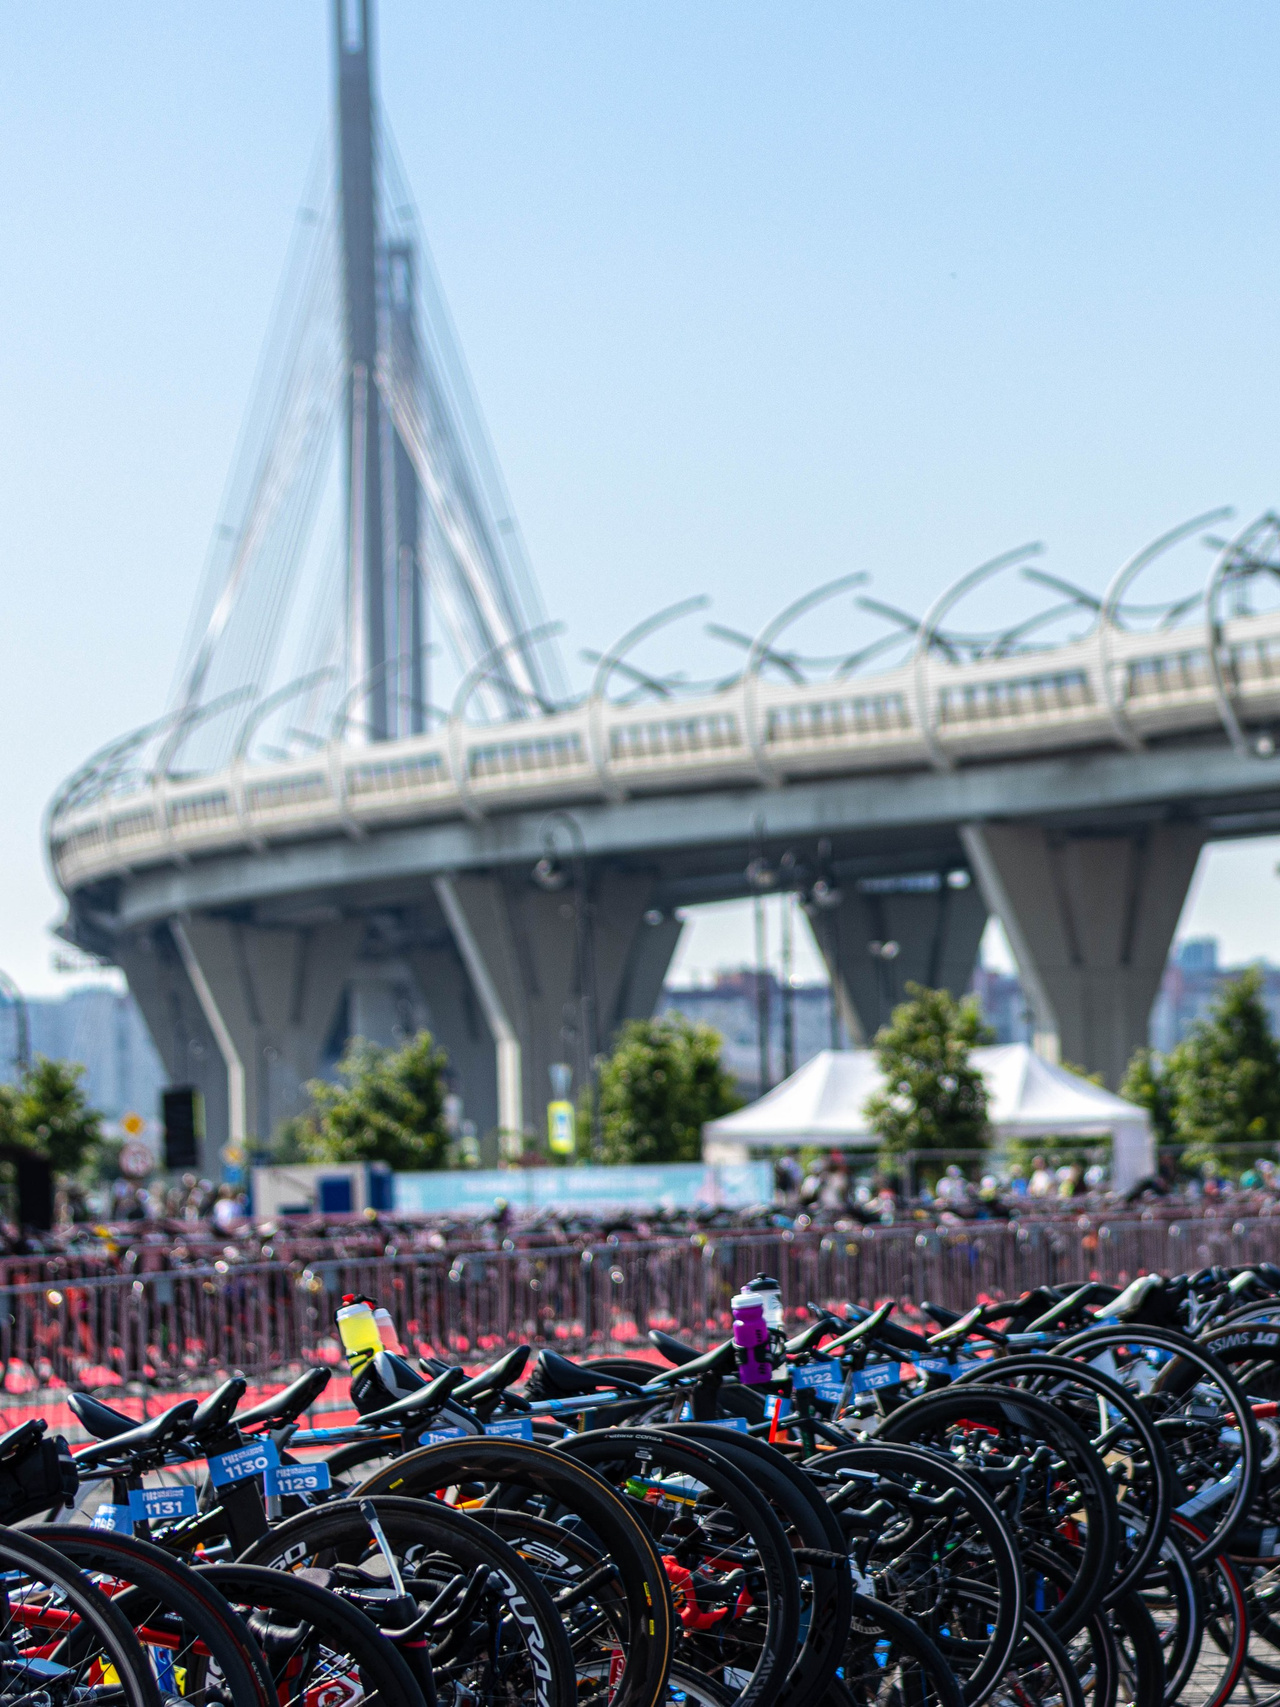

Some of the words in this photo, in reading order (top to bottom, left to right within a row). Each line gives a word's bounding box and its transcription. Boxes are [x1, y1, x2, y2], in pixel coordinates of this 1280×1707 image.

[802, 1372, 833, 1385] 1122
[865, 1374, 890, 1387] 1121
[225, 1456, 269, 1480] 1130
[277, 1475, 318, 1492] 1129
[145, 1500, 184, 1516] 1131
